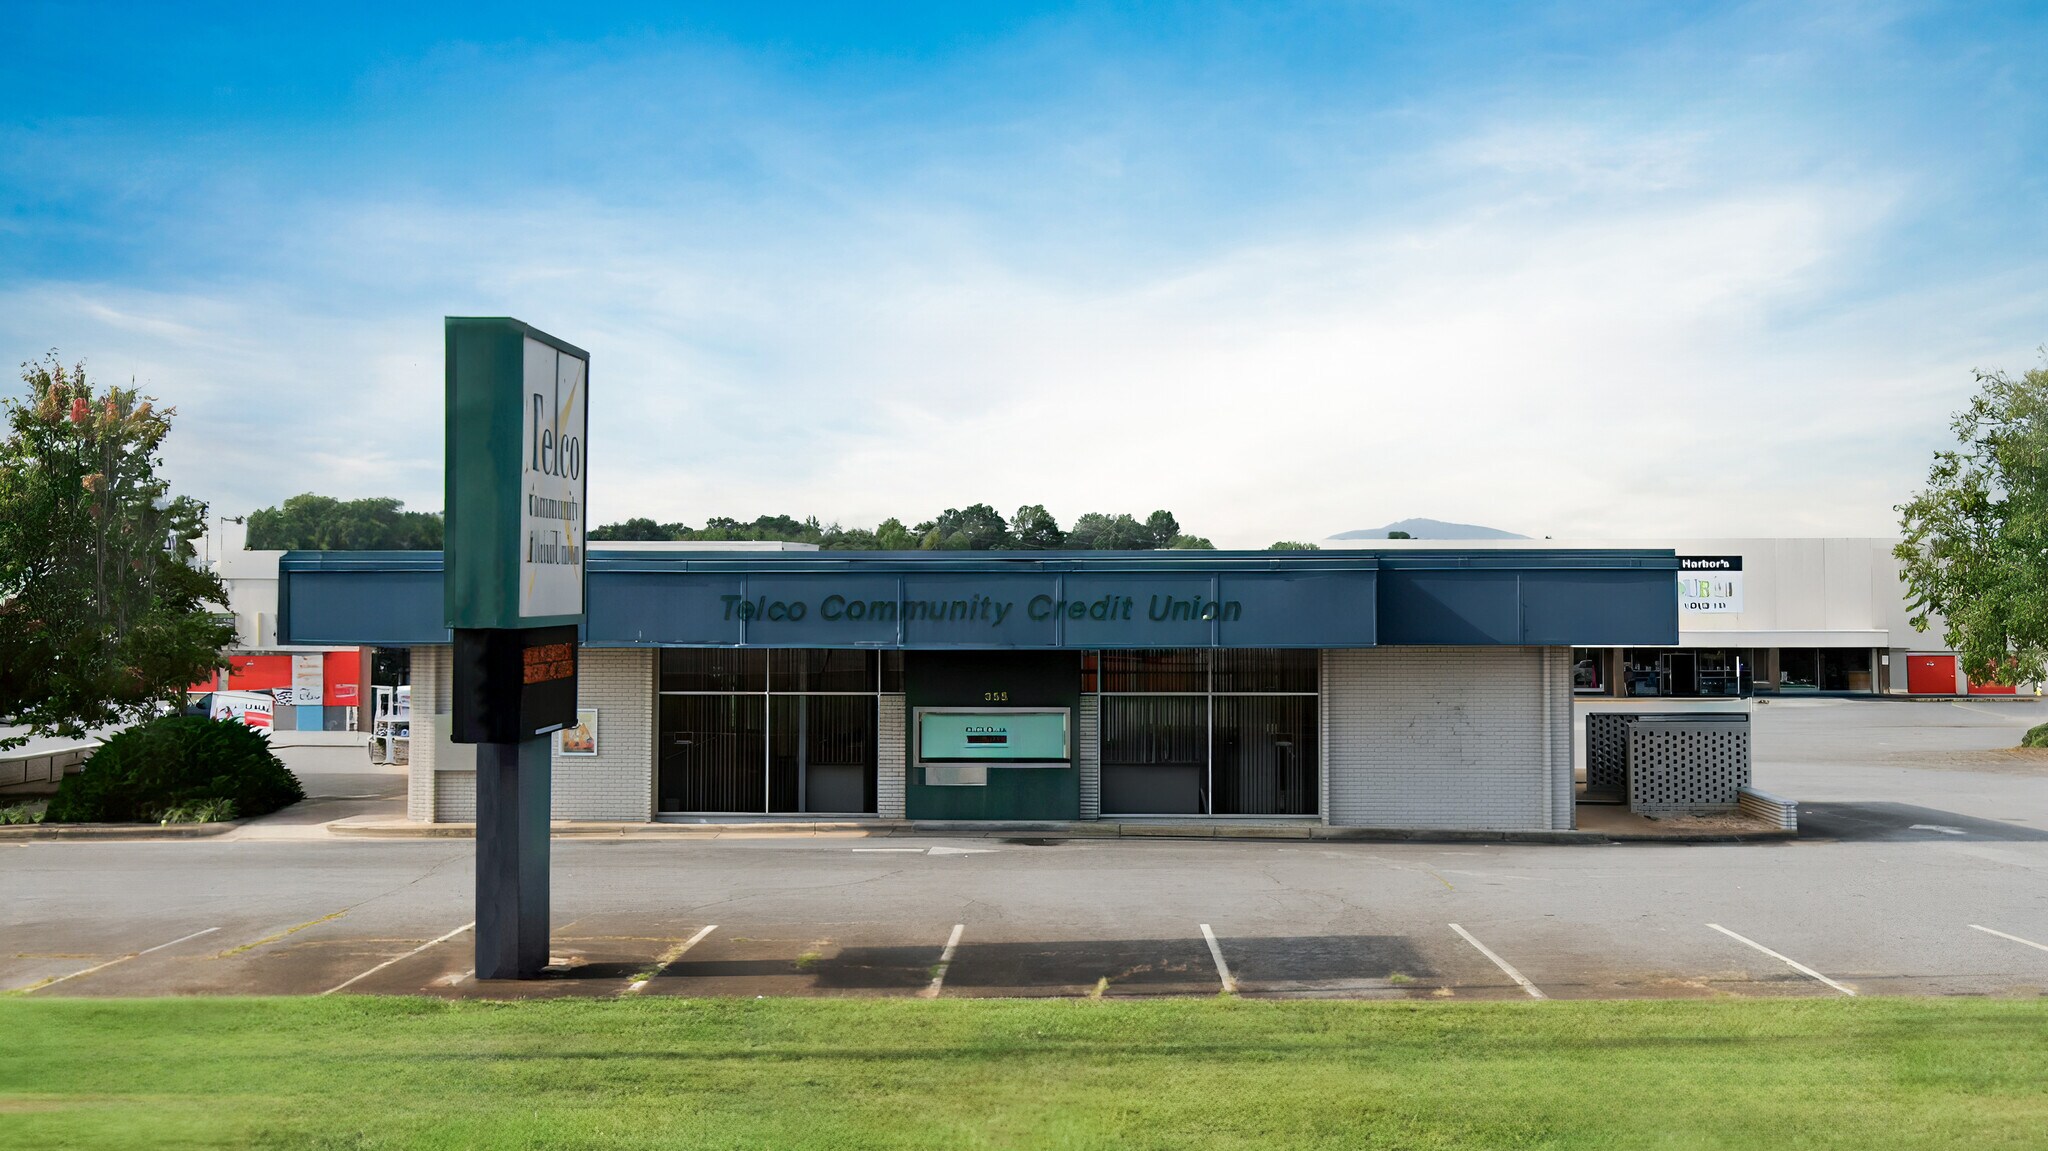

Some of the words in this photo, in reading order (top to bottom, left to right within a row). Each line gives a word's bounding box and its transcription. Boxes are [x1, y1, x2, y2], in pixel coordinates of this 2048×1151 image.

[526, 393, 579, 479] Telco
[720, 594, 807, 622] Telco
[820, 594, 1013, 627] Community
[1027, 594, 1133, 621] Credit
[1149, 594, 1242, 622] Union
